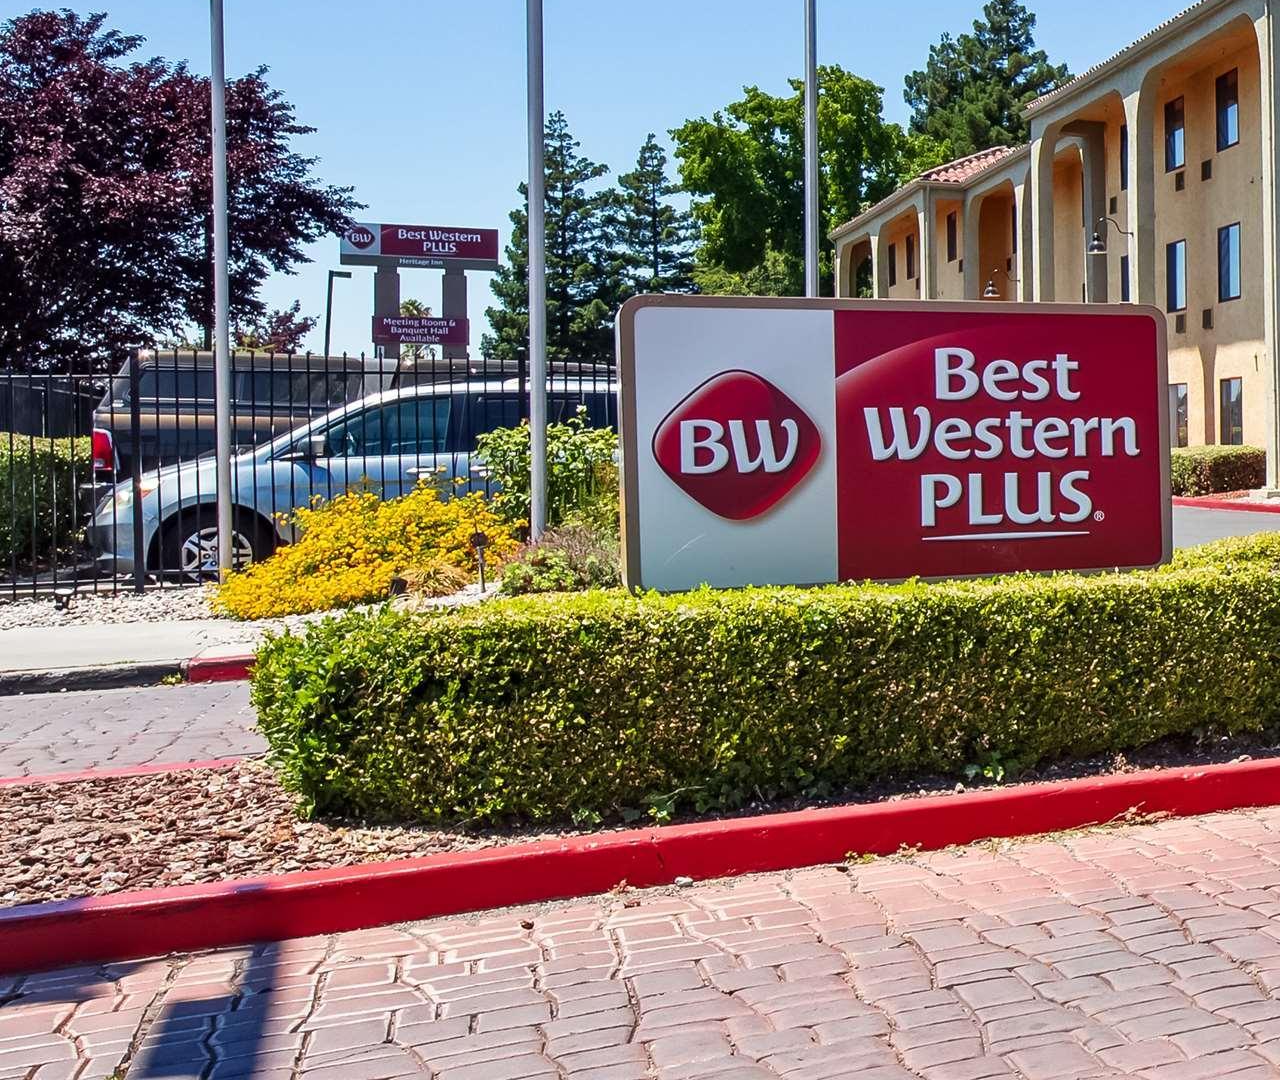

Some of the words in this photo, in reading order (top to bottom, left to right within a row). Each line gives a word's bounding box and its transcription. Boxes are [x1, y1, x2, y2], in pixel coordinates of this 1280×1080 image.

[351, 232, 372, 243] BW
[398, 228, 427, 240] Best
[429, 230, 481, 242] Western
[423, 241, 457, 253] PLUS
[399, 258, 430, 266] Heritage
[383, 318, 420, 327] Meeting
[421, 319, 447, 327] Room
[449, 319, 456, 327] &
[391, 327, 428, 336] Banquet
[430, 327, 449, 335] Hall
[400, 334, 440, 343] Available
[934, 347, 1081, 401] Best
[863, 406, 1141, 461] Western
[680, 419, 799, 474] BW
